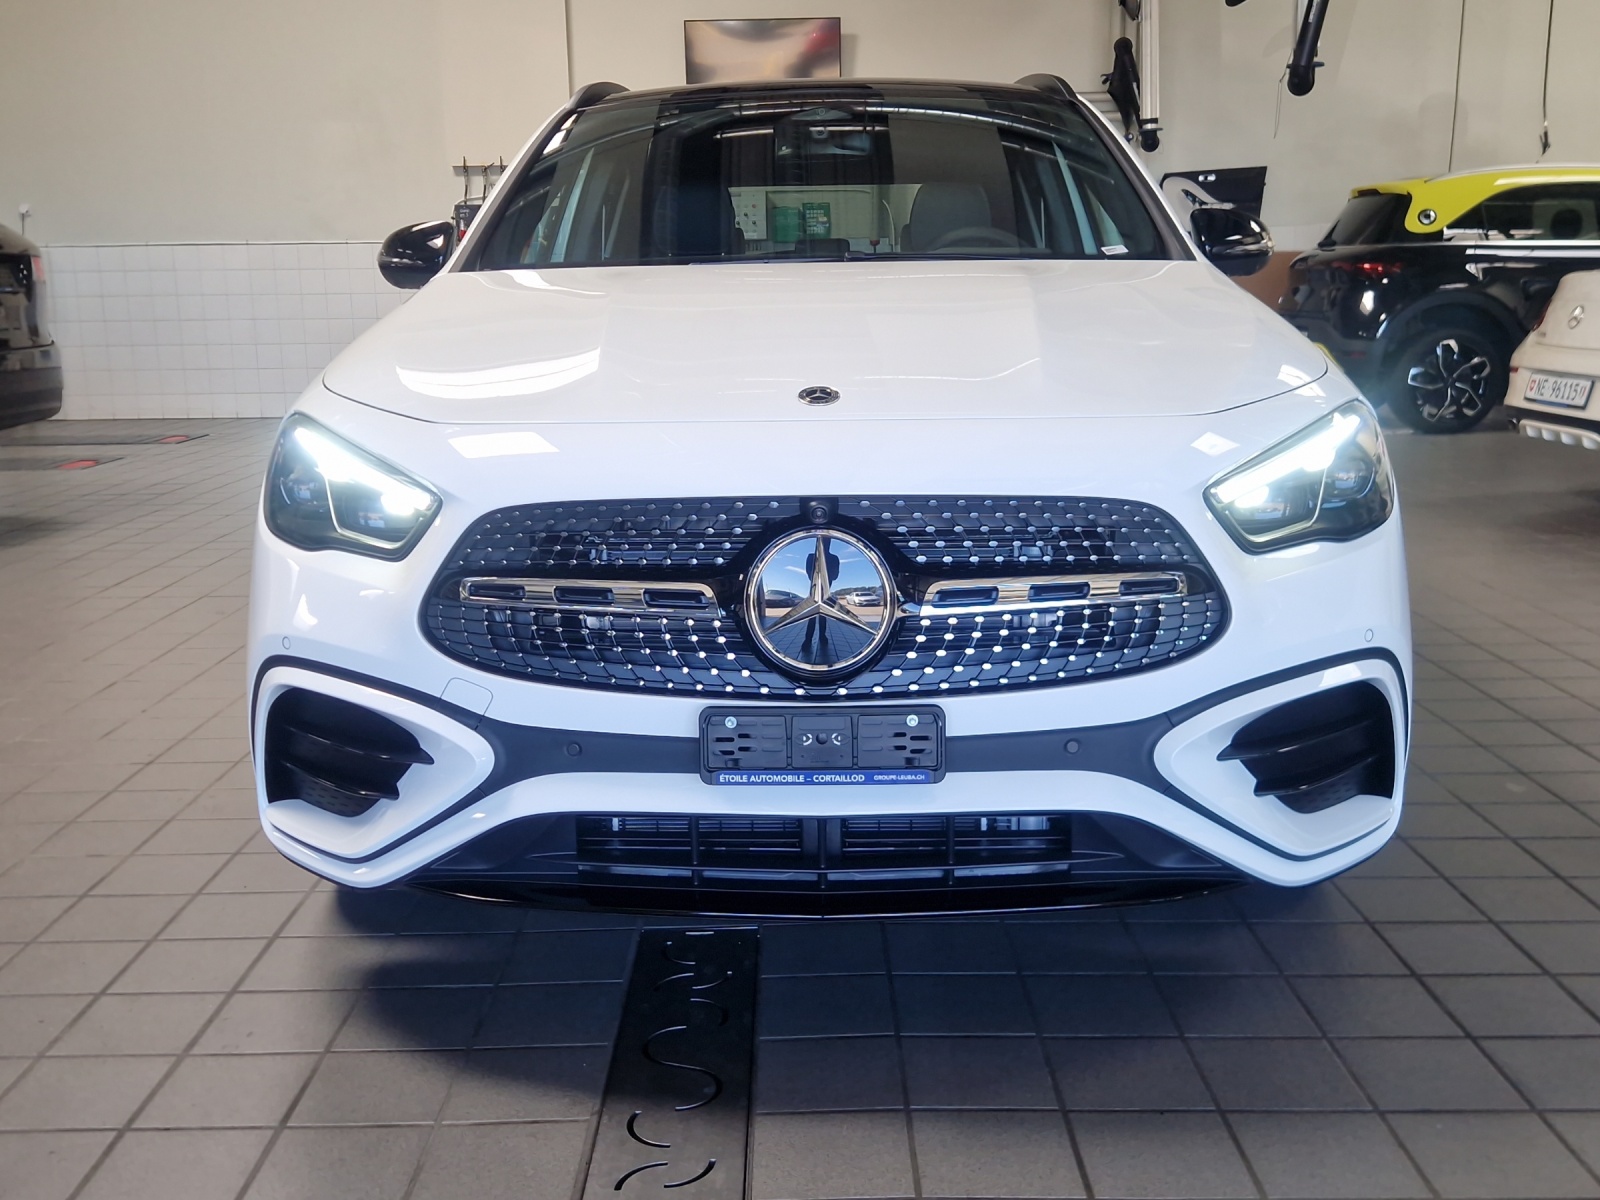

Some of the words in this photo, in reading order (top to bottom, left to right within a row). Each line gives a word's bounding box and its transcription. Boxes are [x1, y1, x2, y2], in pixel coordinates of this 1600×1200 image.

[1534, 377, 1548, 397] NE
[1550, 380, 1580, 401] 96115
[719, 773, 748, 783] ÉTOILE
[749, 774, 805, 783] AUTOMOBILE
[812, 774, 866, 783] CORTAILLOD
